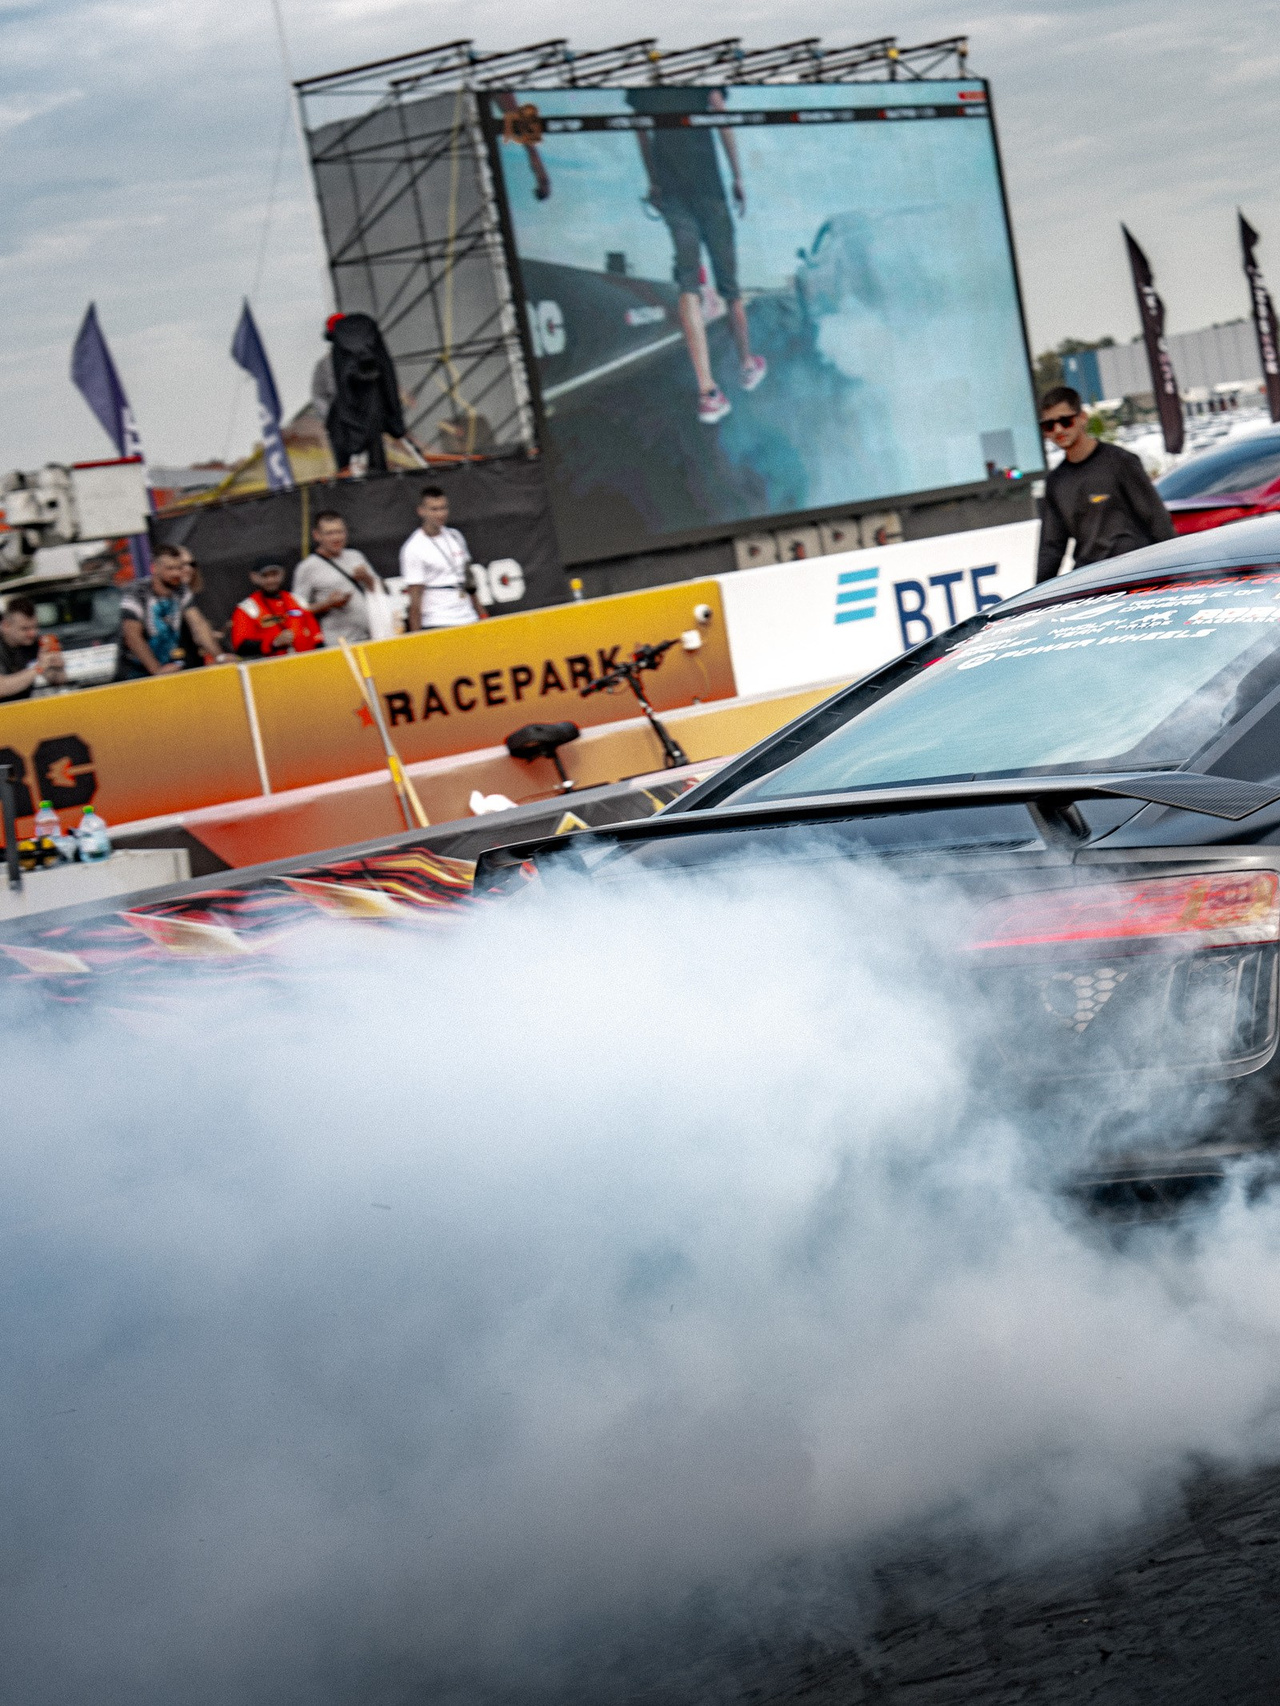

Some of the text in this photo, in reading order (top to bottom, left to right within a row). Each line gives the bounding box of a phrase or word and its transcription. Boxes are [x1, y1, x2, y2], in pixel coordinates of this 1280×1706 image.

[893, 562, 1004, 652] ВТБ
[993, 638, 1097, 662] POWER
[1096, 628, 1217, 647] WHEELS
[383, 644, 625, 727] RACEPARK
